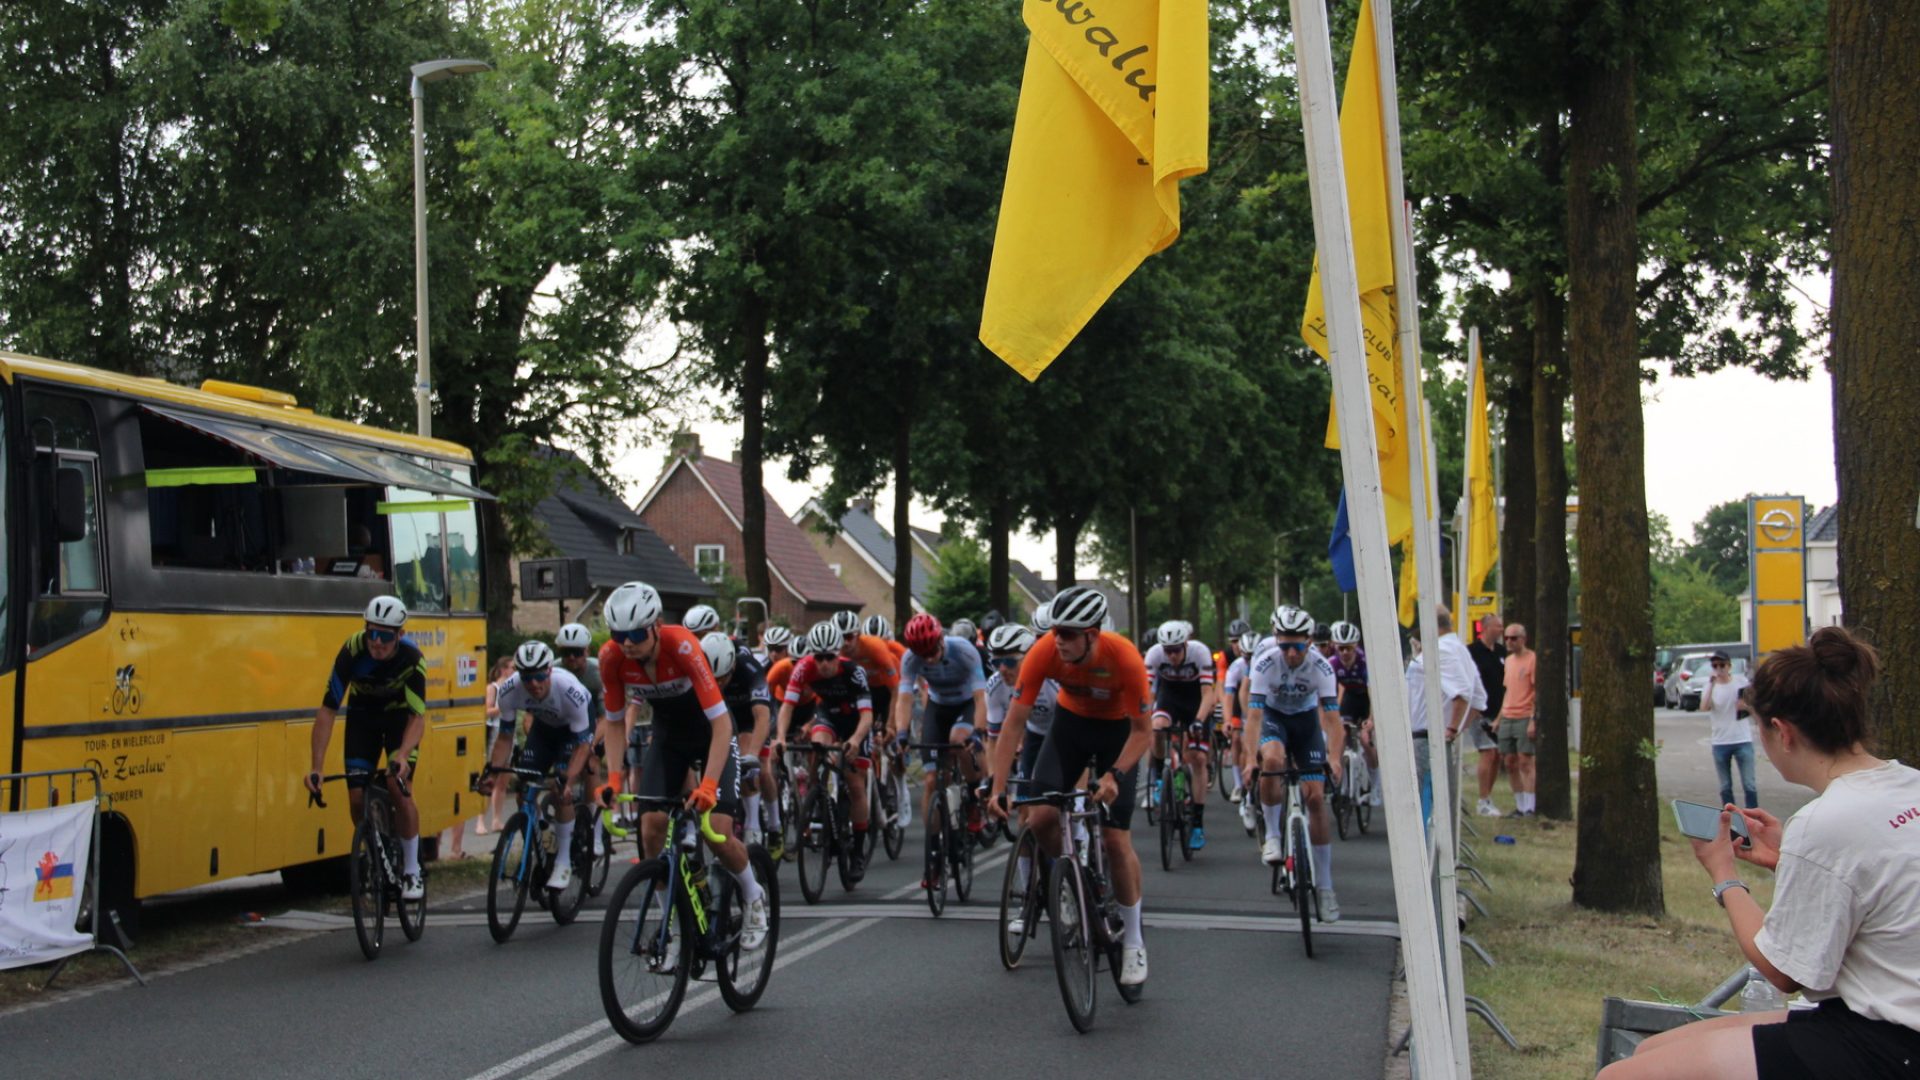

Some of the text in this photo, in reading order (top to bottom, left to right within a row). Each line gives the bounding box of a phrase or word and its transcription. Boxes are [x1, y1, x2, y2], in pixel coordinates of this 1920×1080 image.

[1361, 325, 1393, 363] CLUB
[566, 685, 586, 706] BOM
[111, 737, 121, 749] EN
[123, 733, 165, 749] WIELERCLUB
